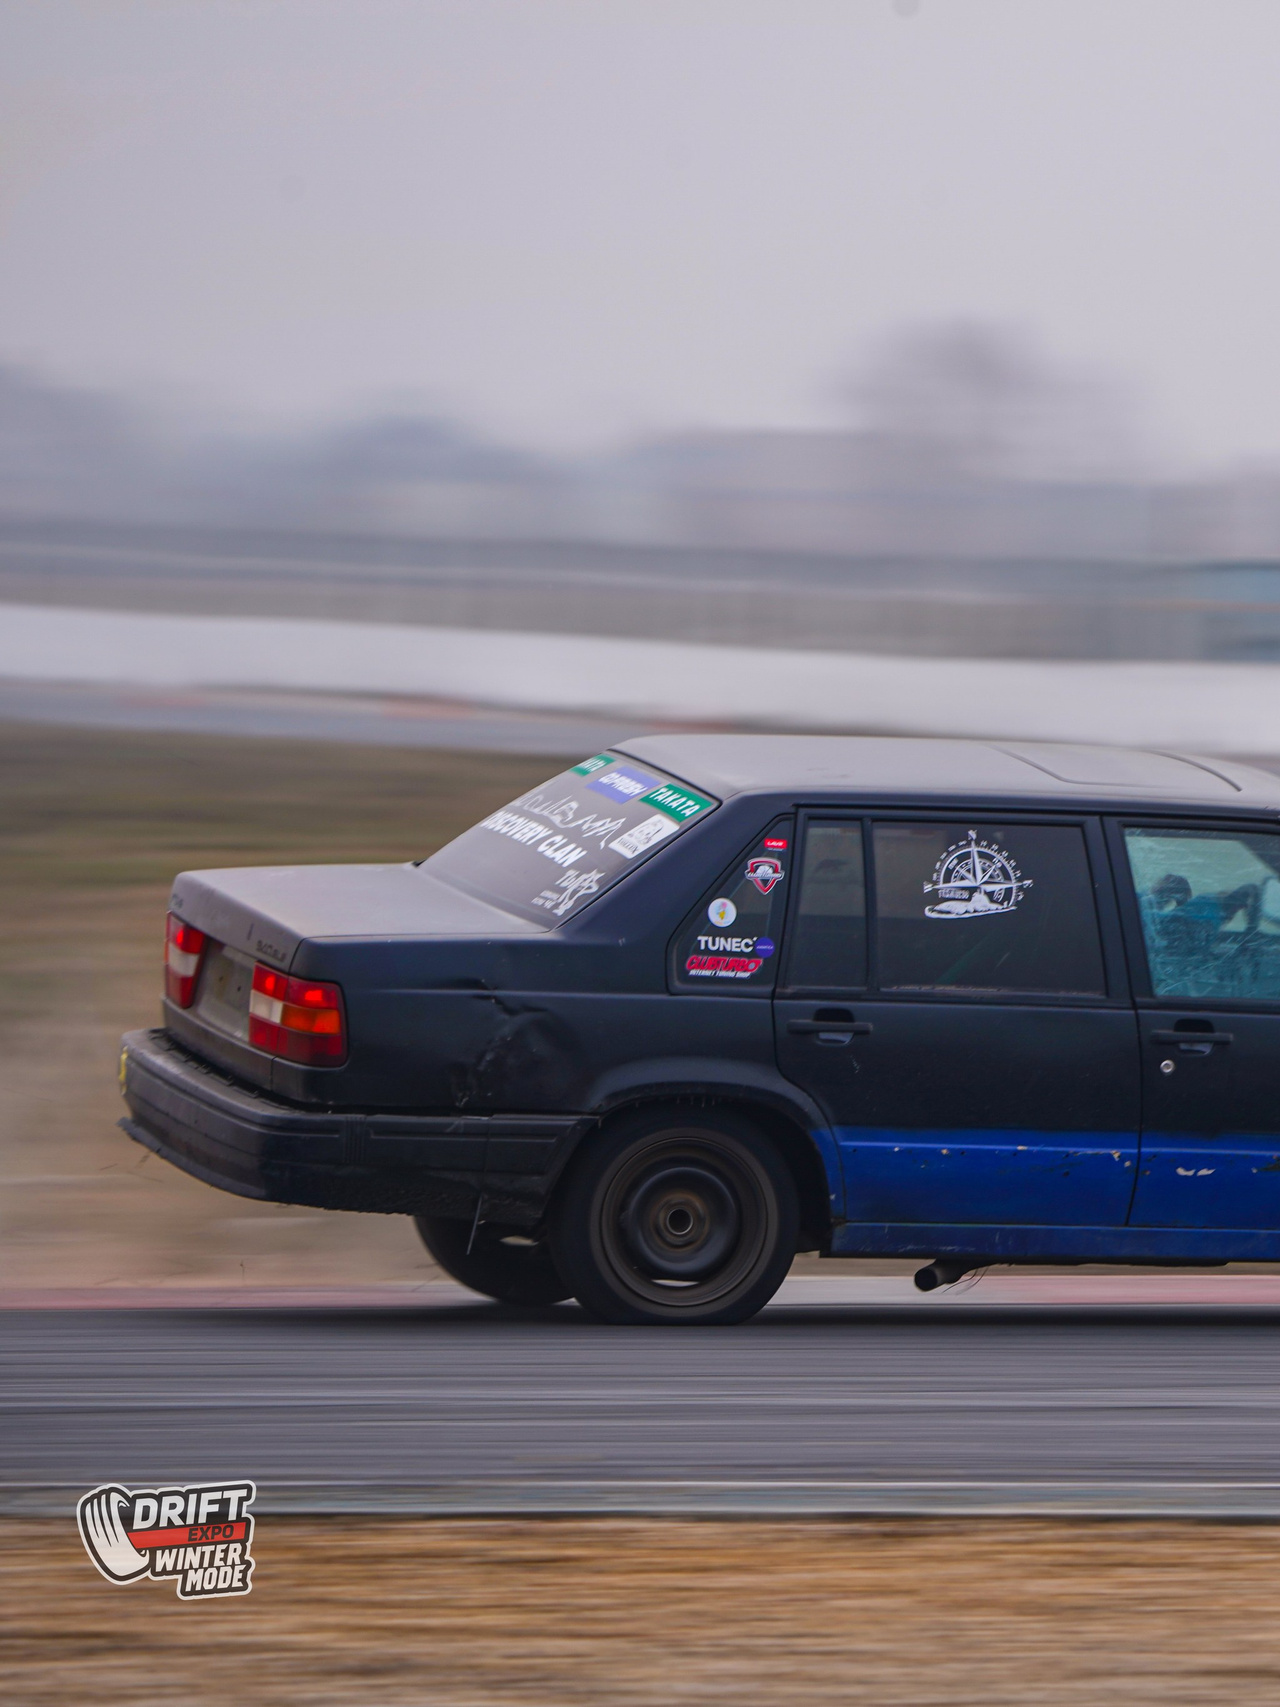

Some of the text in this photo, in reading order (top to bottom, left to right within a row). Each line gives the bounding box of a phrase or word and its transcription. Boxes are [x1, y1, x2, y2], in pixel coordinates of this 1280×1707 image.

[649, 787, 700, 817] TAKATA
[480, 810, 588, 868] DISCOVERY CLAN
